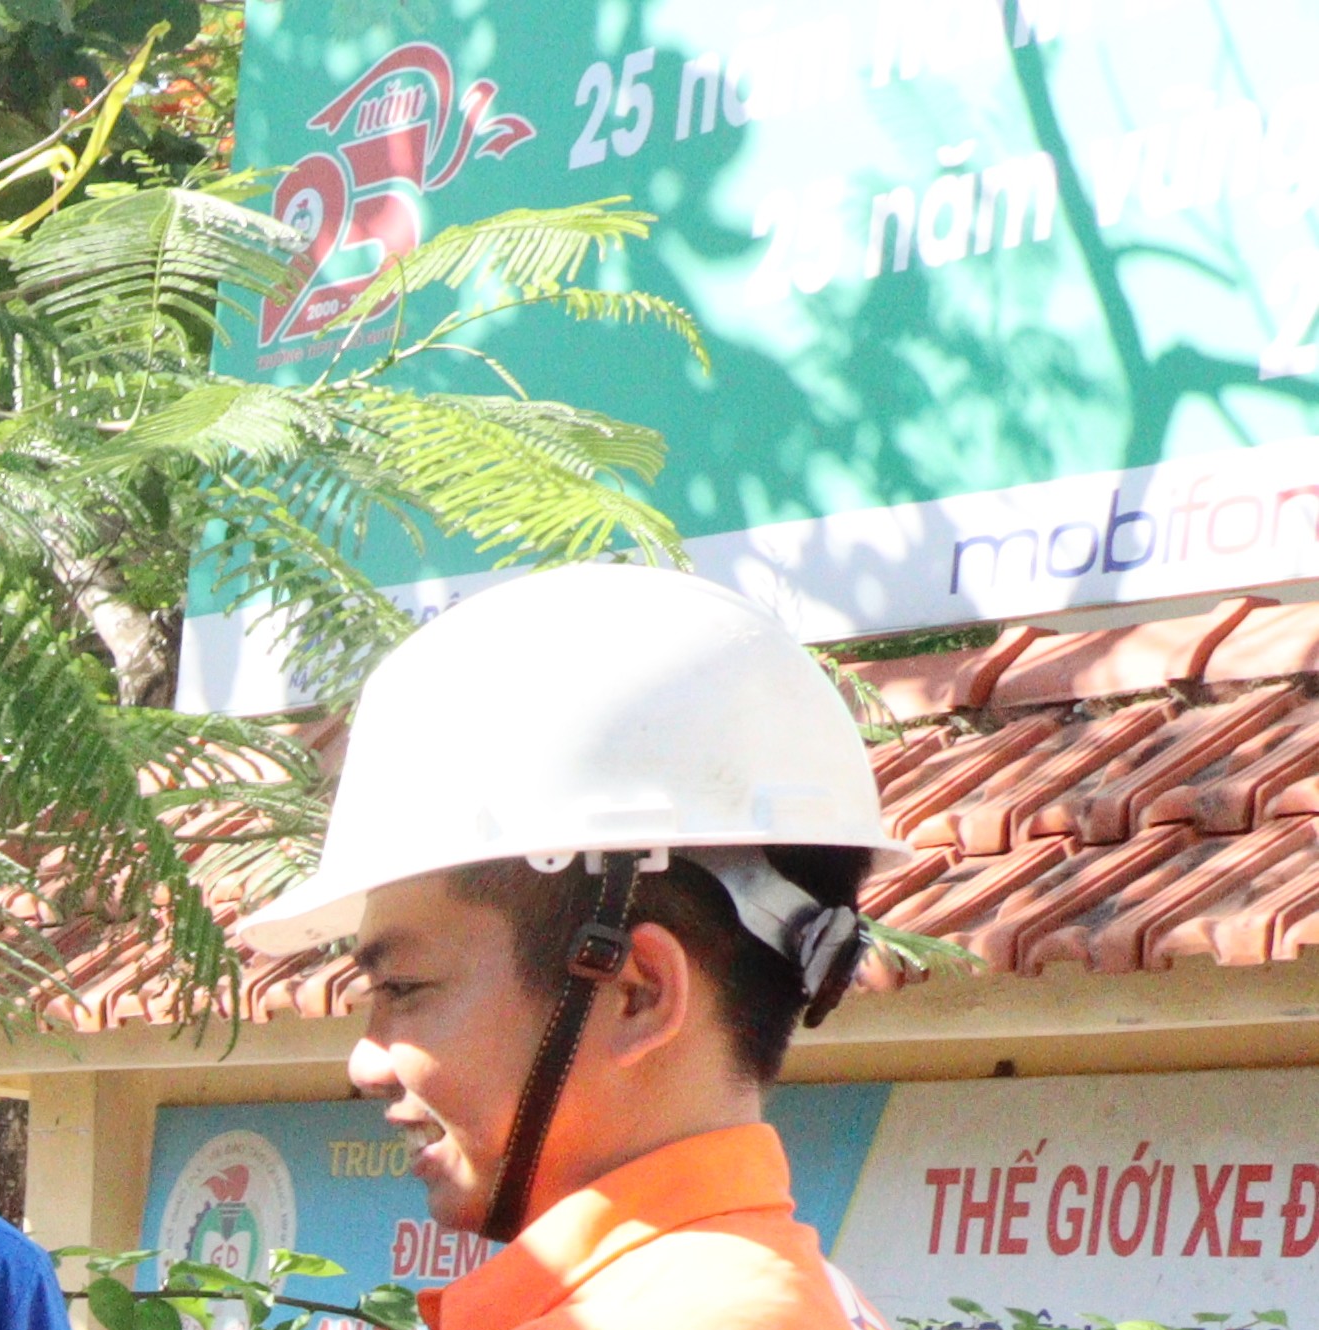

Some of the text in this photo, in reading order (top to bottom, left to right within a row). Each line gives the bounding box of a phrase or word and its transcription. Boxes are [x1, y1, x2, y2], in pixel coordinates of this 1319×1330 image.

[355, 77, 427, 137] năm
[568, 47, 655, 170] 25
[745, 177, 847, 307] 25
[867, 138, 1057, 280] năm
[306, 299, 340, 324] 2000
[925, 1138, 1048, 1255] THẾ
[1047, 1141, 1175, 1257] GIỚI
[1180, 1164, 1274, 1258] XE
